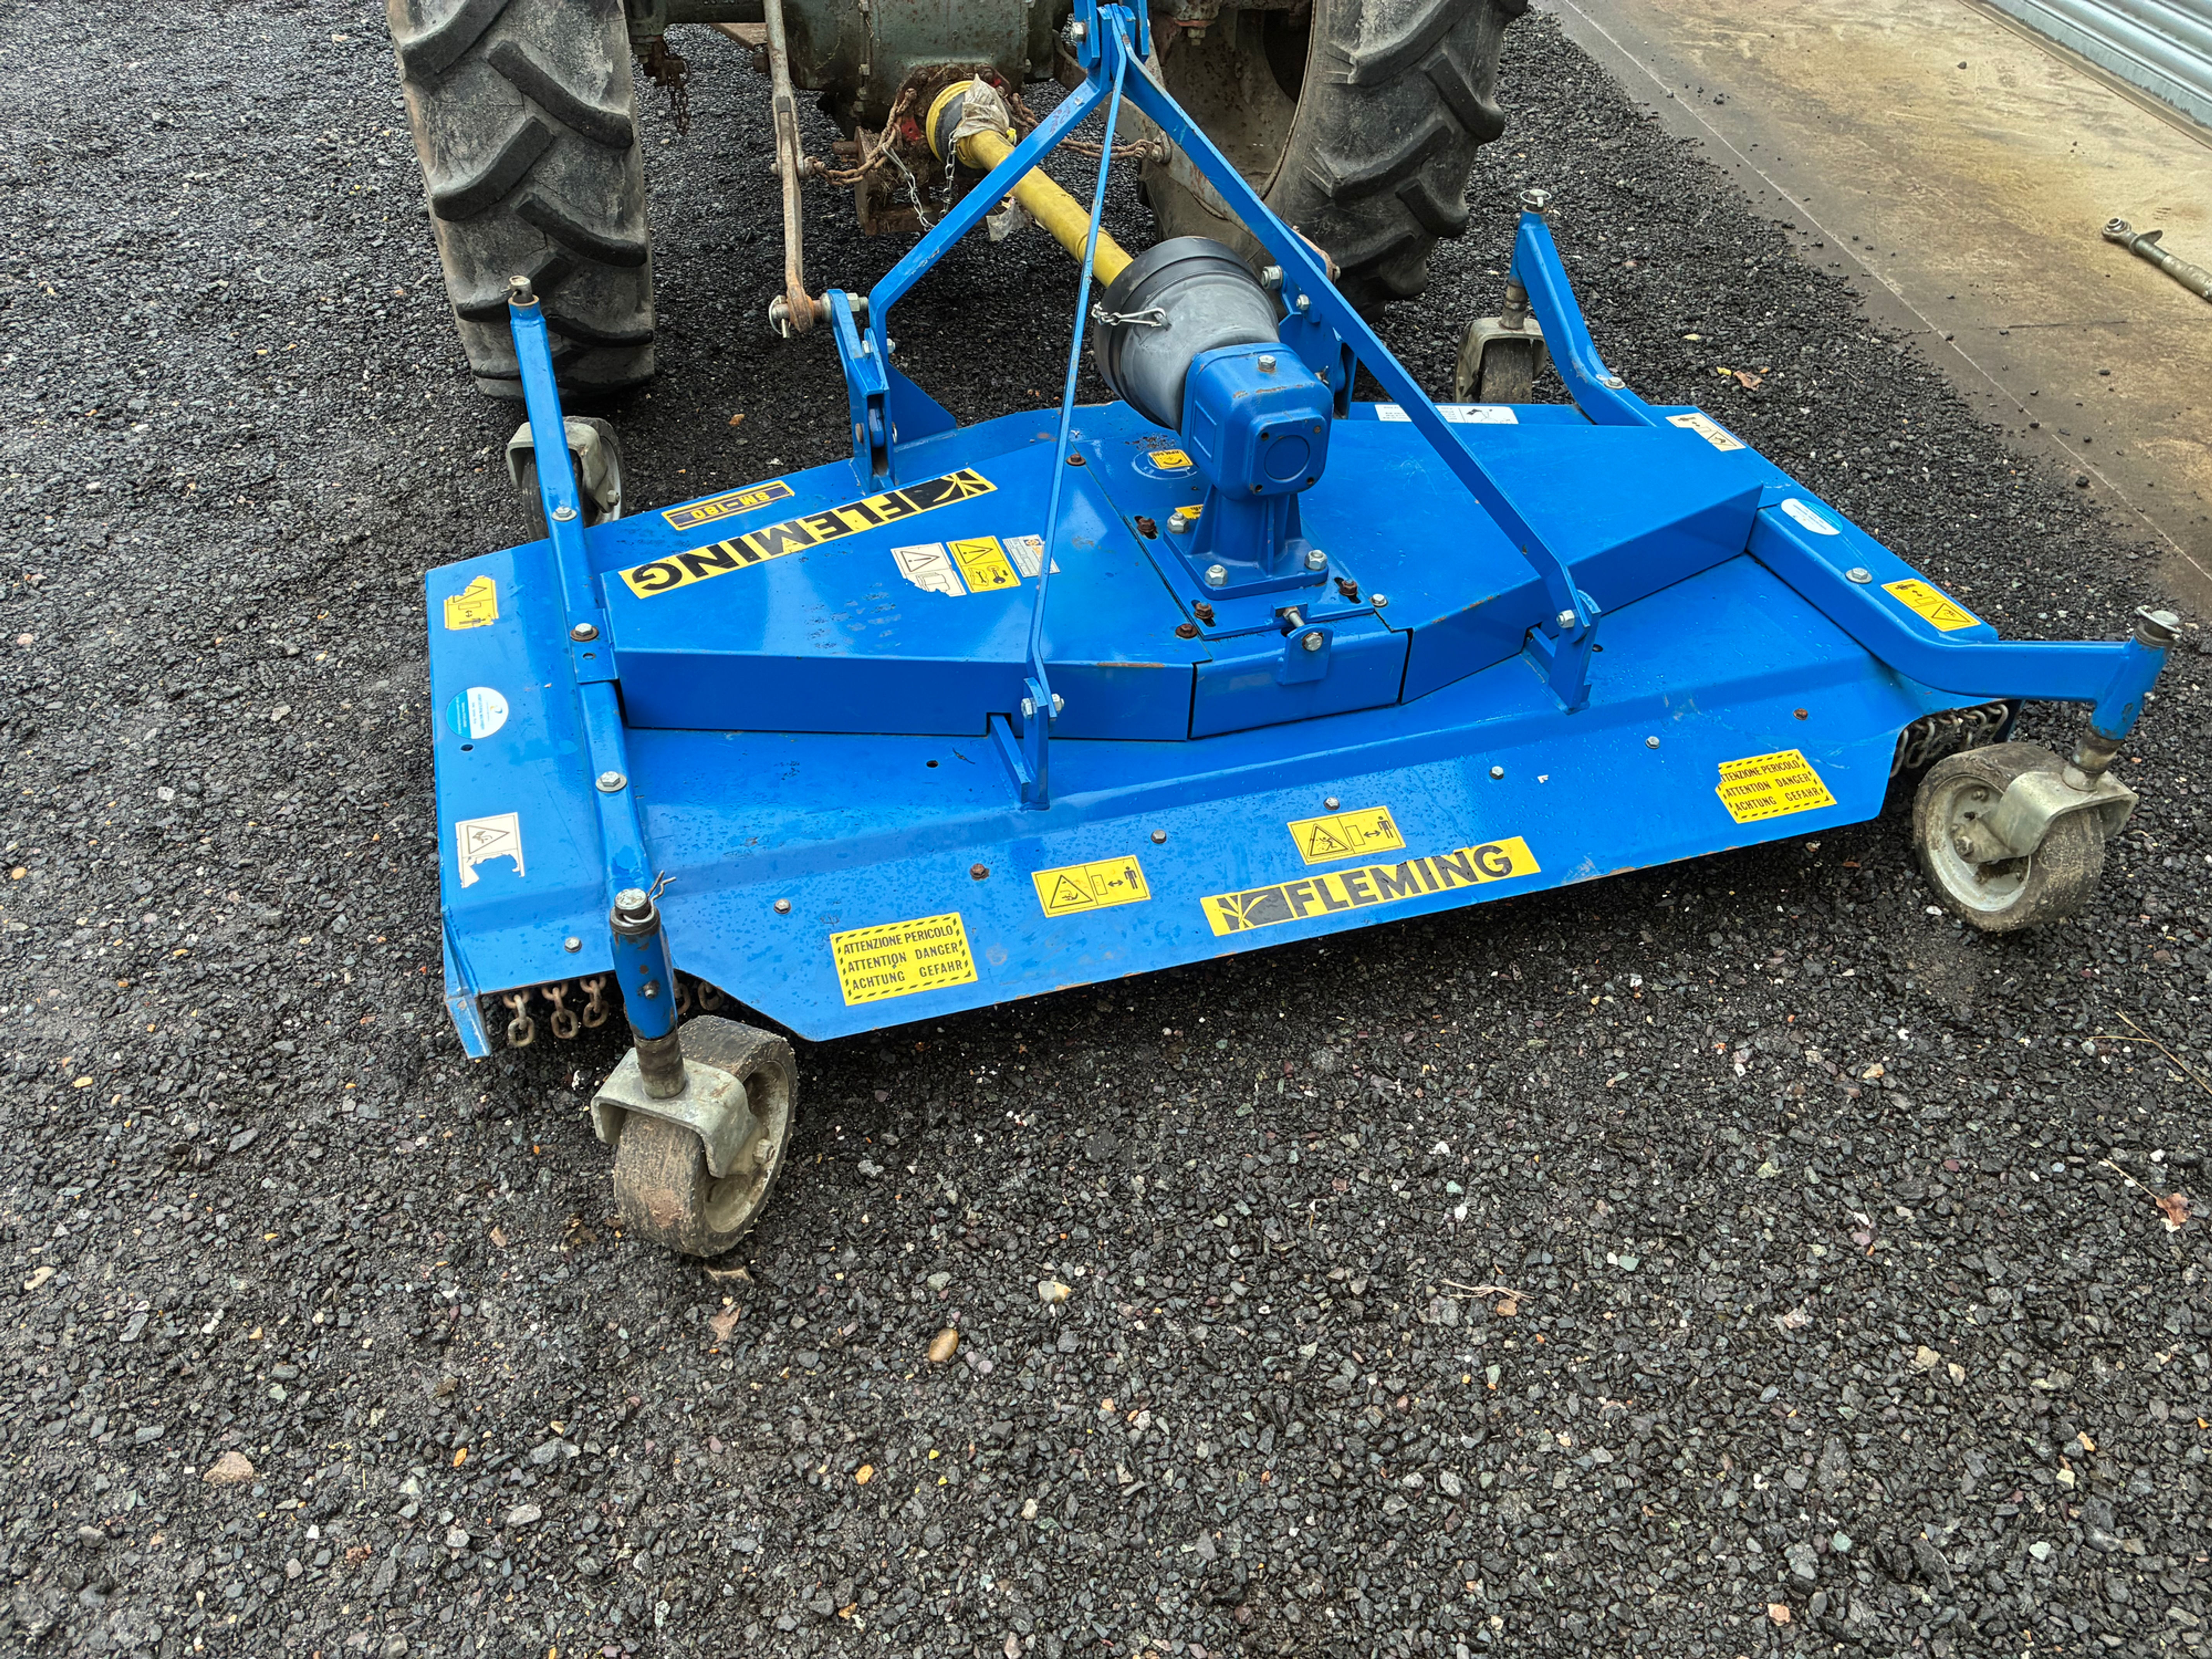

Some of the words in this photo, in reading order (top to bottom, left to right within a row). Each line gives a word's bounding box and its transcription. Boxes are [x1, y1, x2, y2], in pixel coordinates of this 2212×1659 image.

[691, 492, 770, 519] SM-180
[632, 491, 918, 590] FLEMING
[1721, 766, 1762, 782] TTENZIONE
[1762, 760, 1800, 774] PERICOLO
[1726, 781, 1771, 797] ATTENTION
[1775, 773, 1811, 787] DANGER
[1735, 796, 1777, 811] ACHTUNG
[1785, 788, 1820, 802] GEFAHR
[1285, 845, 1513, 918] FLEMING
[844, 935, 902, 954] ATTENZIONE
[905, 925, 953, 943] PERICOLO
[848, 952, 907, 972] ATTENTION
[915, 943, 958, 960] DANGER
[853, 971, 905, 990] ACHTUNG
[919, 960, 963, 977] GEFAHR
